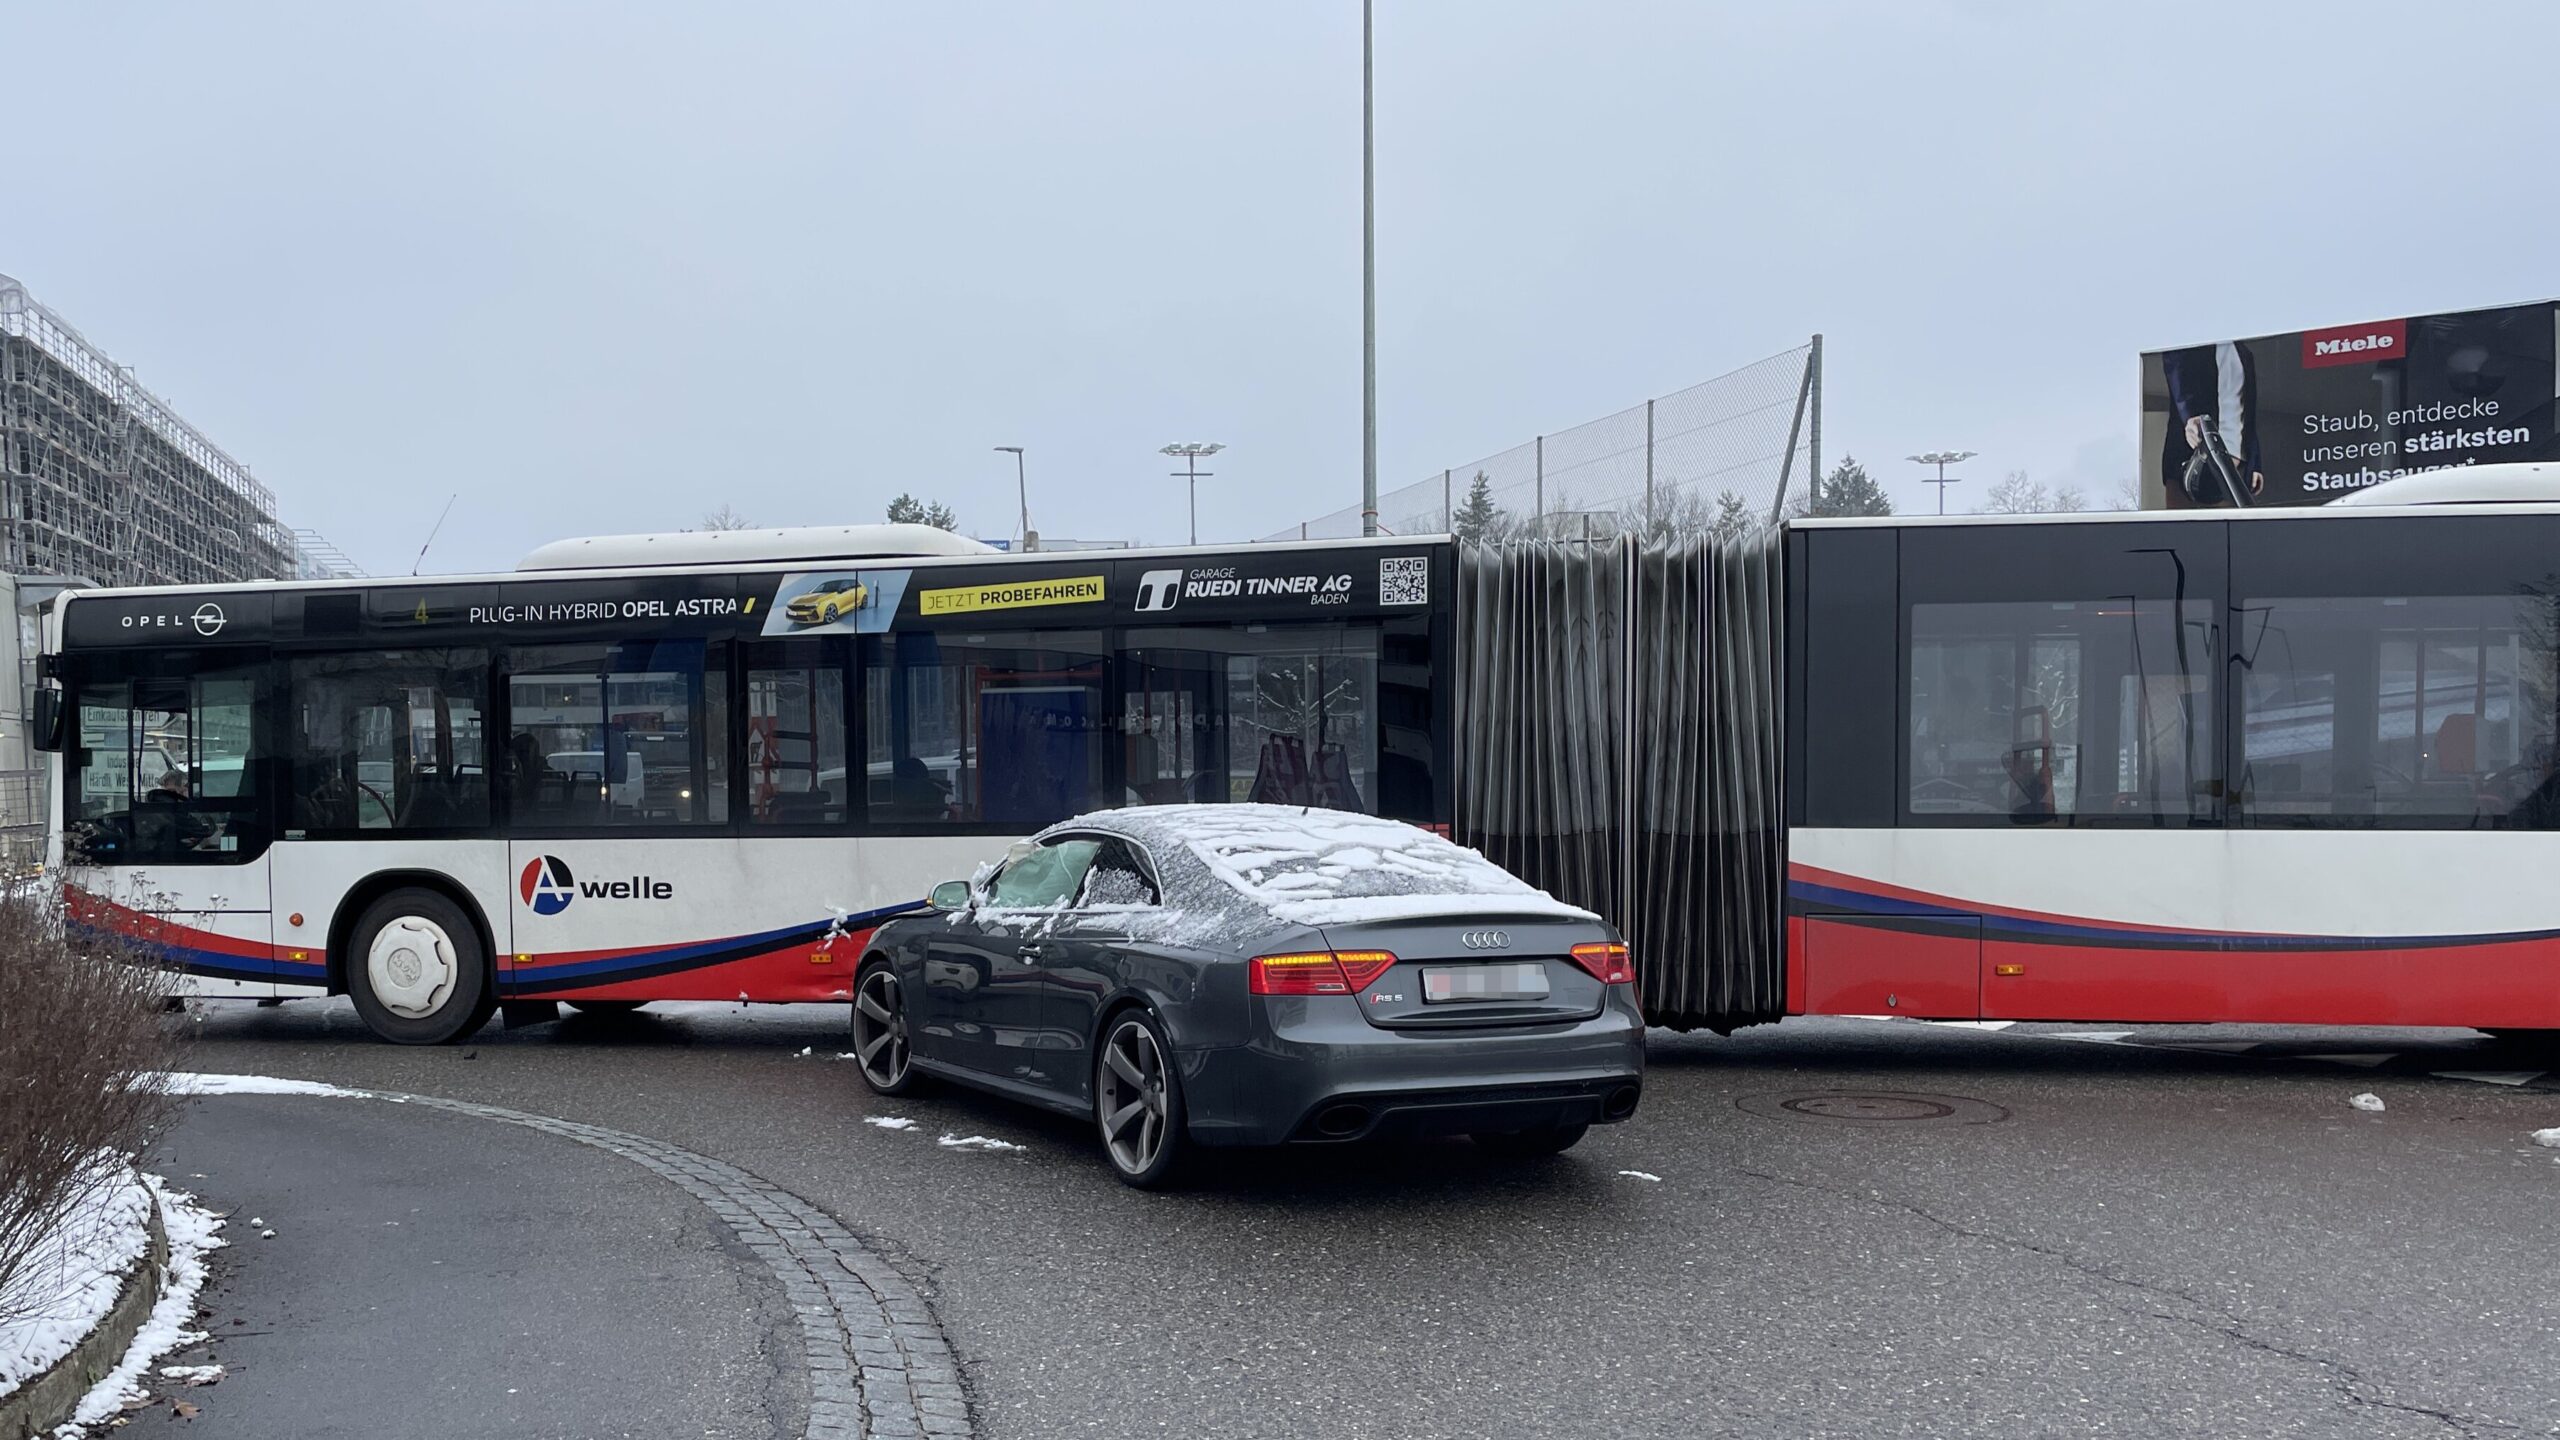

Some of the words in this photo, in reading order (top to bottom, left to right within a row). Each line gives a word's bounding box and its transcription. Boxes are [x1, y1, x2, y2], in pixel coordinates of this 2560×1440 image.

[2314, 335, 2394, 356] Miele
[2303, 409, 2379, 434] Staub,
[2387, 397, 2499, 426] entdecke
[2303, 440, 2397, 463] unseren
[2405, 426, 2530, 454] stärksten
[1185, 579, 1242, 598] RUEDI
[1247, 575, 1318, 595] TINNER
[1320, 574, 1352, 592] AG
[1190, 568, 1236, 580] GARAGE
[928, 593, 975, 610] JETZT
[980, 583, 1097, 605] PROBEFAHREN
[1310, 593, 1349, 605] BADEN
[121, 615, 183, 627] OPEL
[415, 597, 429, 625] 4
[470, 605, 543, 623] PLUG-IN
[549, 602, 617, 620] HYBRID
[622, 600, 670, 617] OPEL
[675, 598, 737, 616] ASTRA
[580, 876, 672, 899] welle
